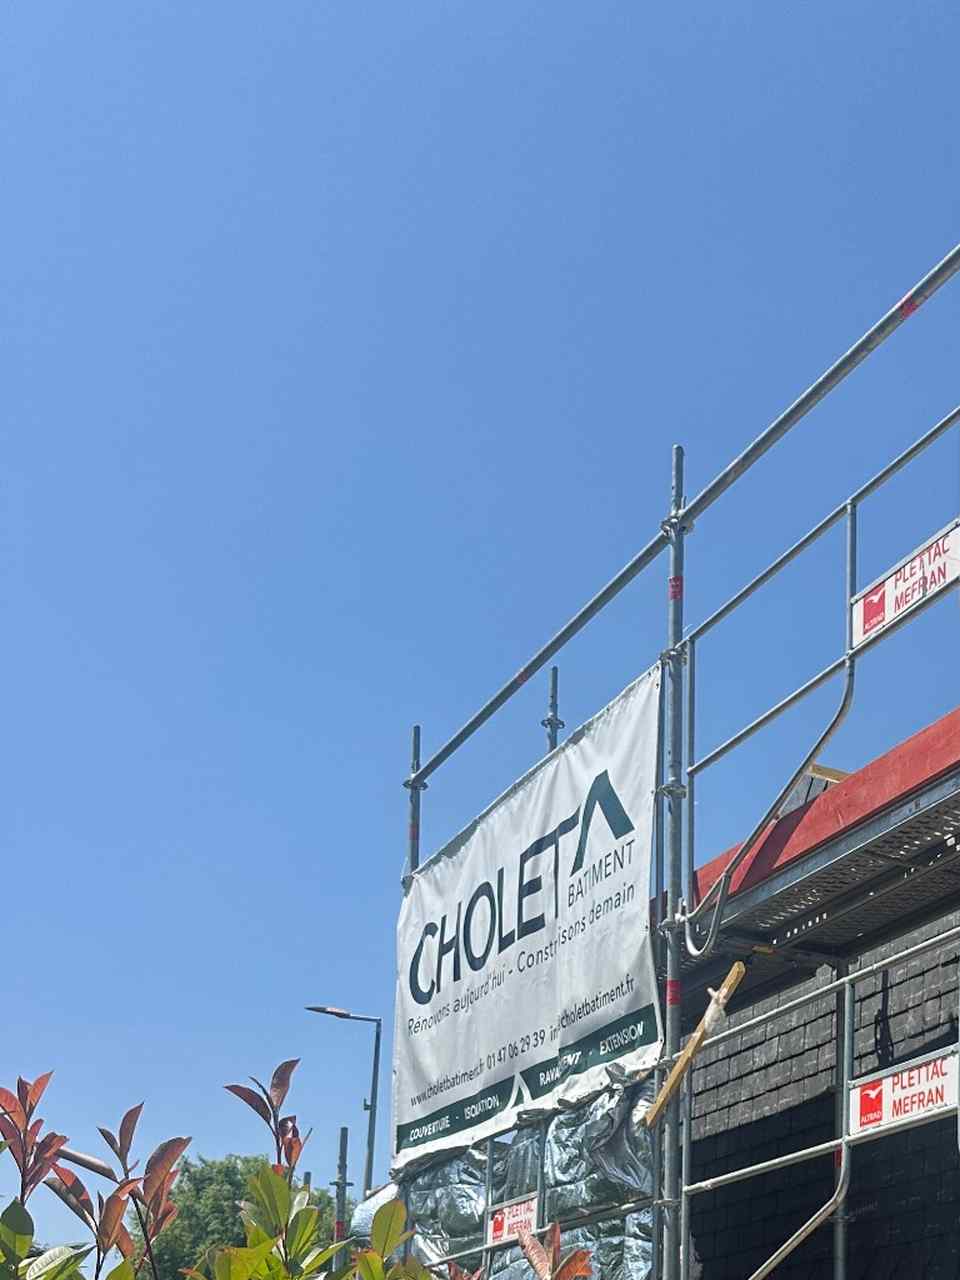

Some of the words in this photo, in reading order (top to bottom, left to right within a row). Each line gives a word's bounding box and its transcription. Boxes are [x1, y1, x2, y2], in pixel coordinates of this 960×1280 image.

[894, 534, 950, 588] PLETTAC
[894, 563, 946, 613] MEFRAN
[567, 839, 635, 907] BATIMENT
[409, 804, 580, 1005] CHOLET
[516, 916, 586, 973] Constrisons
[588, 882, 636, 925] demain
[508, 1041, 519, 1059] 06
[520, 1034, 531, 1053] 29
[533, 1028, 546, 1048] 39
[892, 1056, 948, 1092] PLETTAC
[409, 1115, 451, 1141] COUVERTURE
[464, 1094, 500, 1120] ISOLATION
[892, 1085, 944, 1118] MEFRAN
